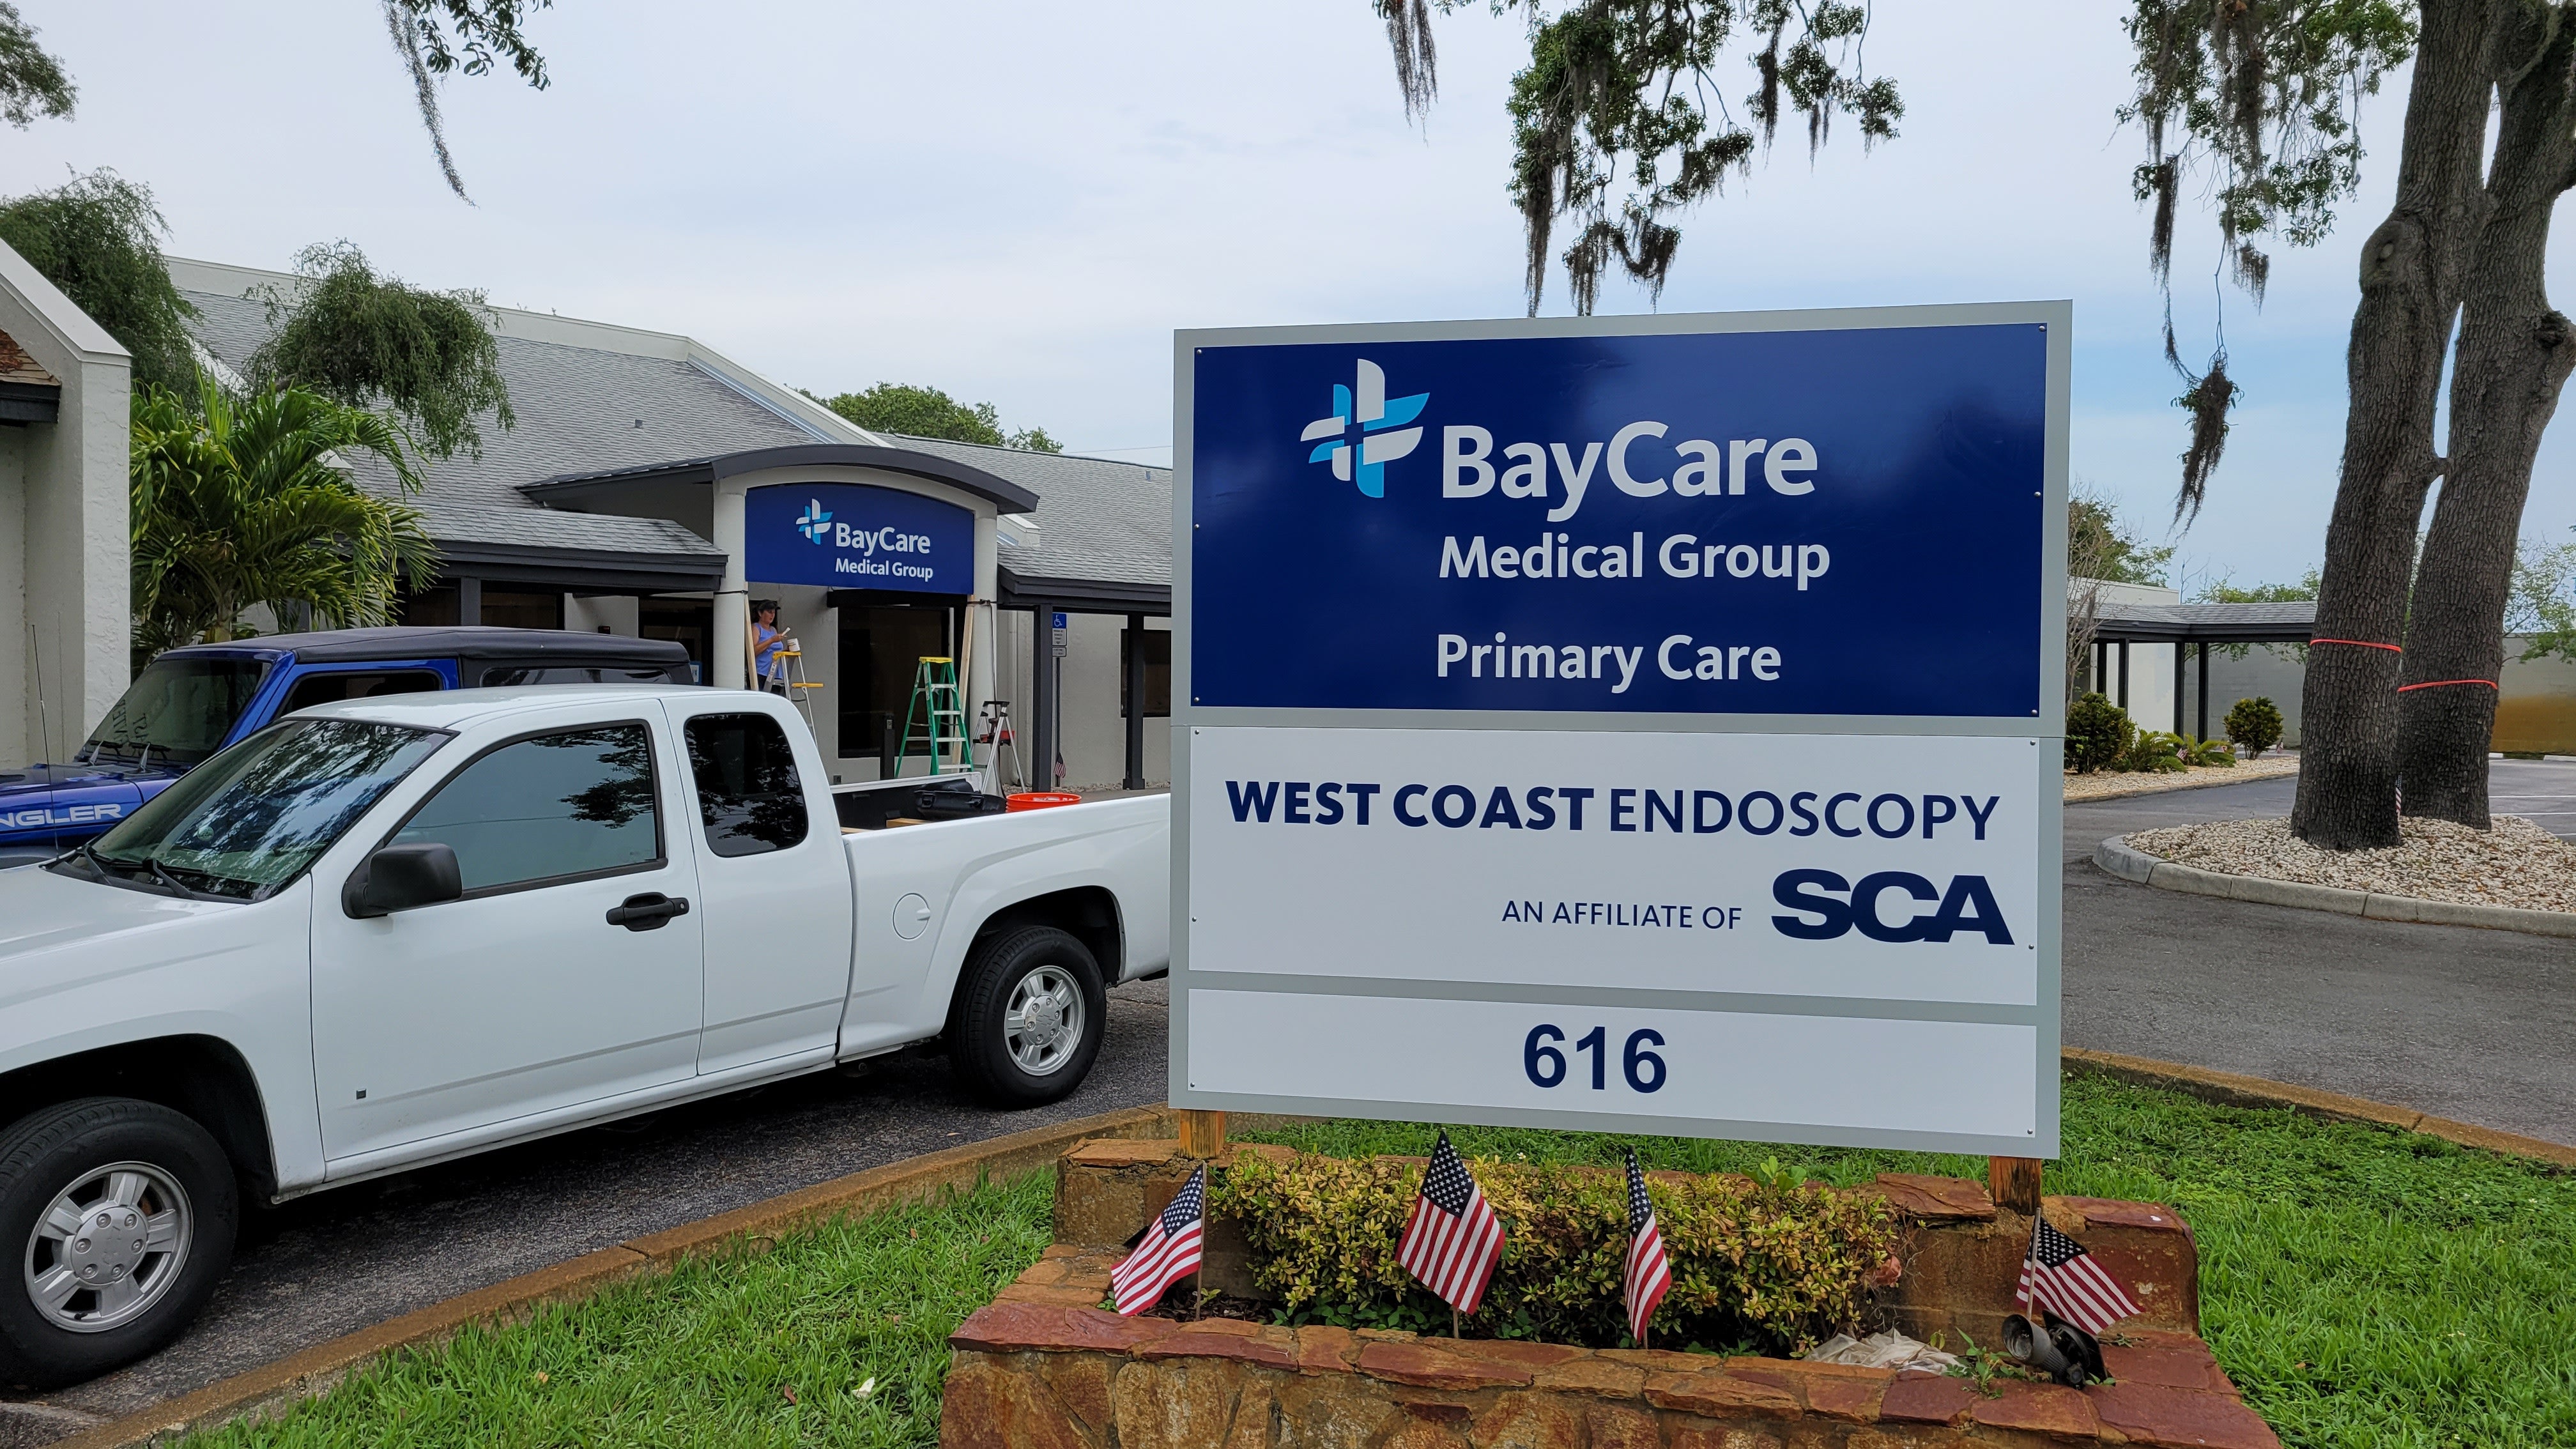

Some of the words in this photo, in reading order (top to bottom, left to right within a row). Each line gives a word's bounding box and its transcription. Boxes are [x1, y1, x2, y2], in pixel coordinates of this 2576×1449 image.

[1443, 420, 1818, 522] BayCare
[835, 558, 889, 576] Medical
[892, 562, 933, 582] Group
[836, 523, 931, 556] BayCare
[1439, 532, 1643, 578] Medical
[1659, 533, 1830, 591] Group
[1438, 632, 1644, 694] Primary
[1658, 634, 1781, 681] Care
[1225, 780, 1381, 825] WEST
[1393, 784, 1595, 831] COAST
[1610, 788, 2000, 841] ENDOSCOPY
[1501, 900, 1543, 923] AN
[1552, 901, 1692, 928] AFFILIATE
[1702, 906, 1742, 930] OF
[1771, 868, 2015, 946] SCA
[1524, 1023, 1667, 1094] 616
